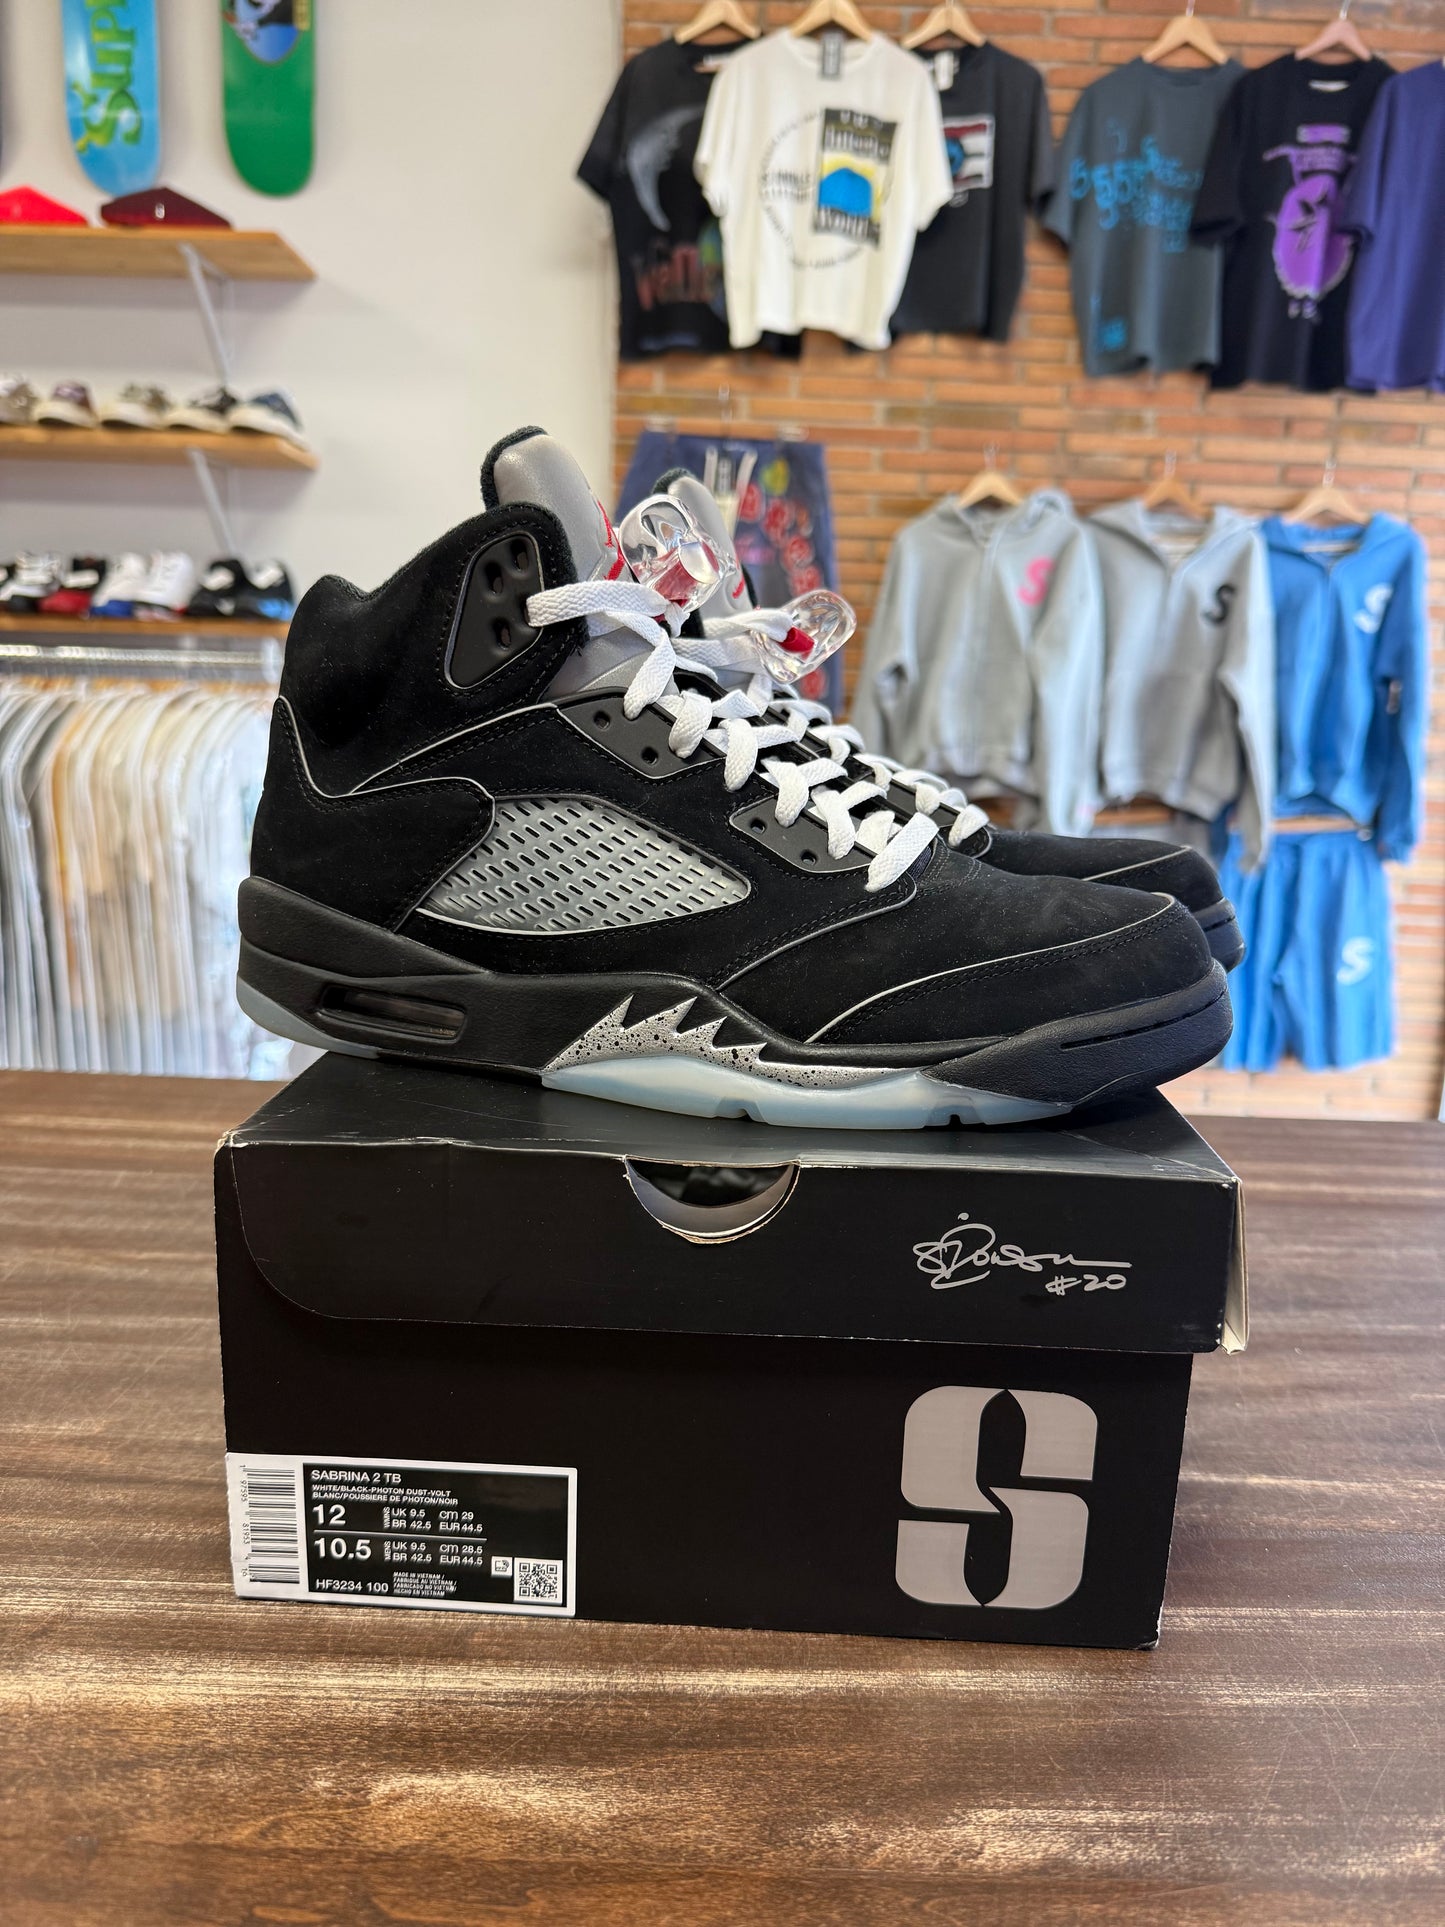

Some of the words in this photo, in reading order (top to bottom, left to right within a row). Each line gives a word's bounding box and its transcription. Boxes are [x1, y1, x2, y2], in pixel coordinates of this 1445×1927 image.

[1018, 557, 1055, 607] S
[1202, 583, 1235, 625] S
[1355, 583, 1393, 634] S
[1336, 938, 1374, 985] S
[1045, 1273, 1127, 1296] #20
[311, 1469, 370, 1483] SABRINA
[373, 1472, 381, 1483] 2
[384, 1472, 402, 1484] TB
[312, 1484, 404, 1495] WHITE/BLACK-PHOTON
[406, 1488, 451, 1497] DUST-VOLT
[390, 1494, 400, 1502] DE
[403, 1495, 458, 1505] PHOTON/NOIR
[895, 1385, 1098, 1610] S
[312, 1503, 346, 1525] 12
[392, 1508, 407, 1517] UK
[410, 1508, 426, 1518] 9.5
[461, 1511, 474, 1520] 29
[392, 1520, 407, 1529] BR
[410, 1520, 432, 1530] 42.5
[439, 1522, 460, 1531] EUR
[461, 1523, 483, 1533] 44.5
[313, 1537, 372, 1560] 10.5
[393, 1541, 407, 1551] UK
[410, 1542, 426, 1551] 9.5
[461, 1544, 483, 1554] 28.5
[393, 1553, 407, 1562] BR
[410, 1553, 432, 1563] 42.5
[439, 1555, 460, 1565] EUR
[461, 1556, 483, 1566] 44.5
[316, 1579, 362, 1591] HF3234
[367, 1582, 389, 1593] 100
